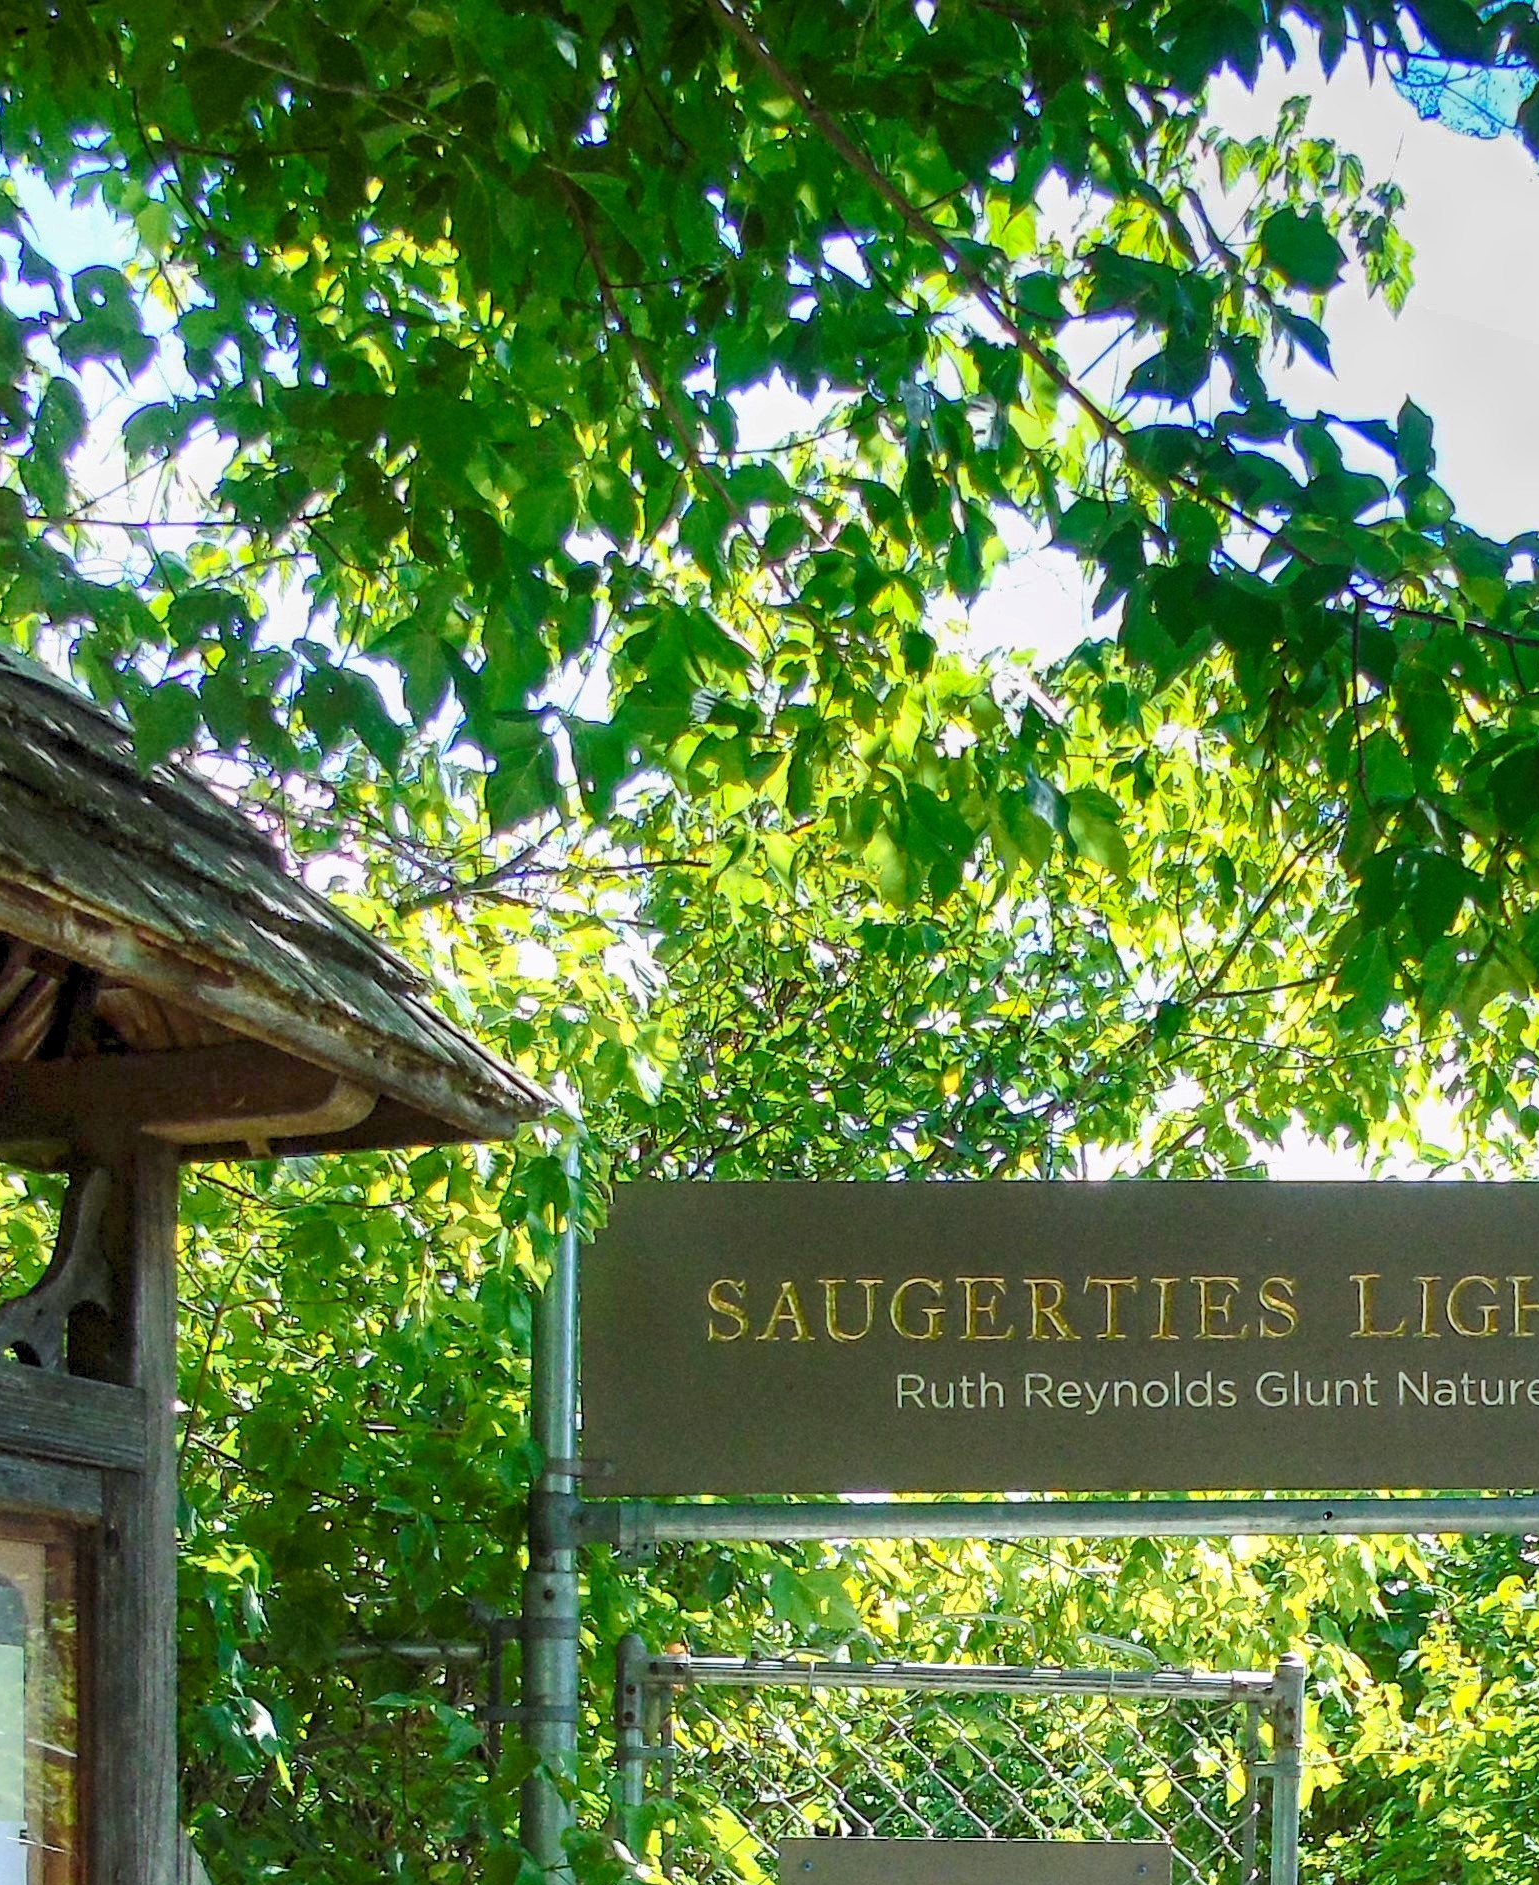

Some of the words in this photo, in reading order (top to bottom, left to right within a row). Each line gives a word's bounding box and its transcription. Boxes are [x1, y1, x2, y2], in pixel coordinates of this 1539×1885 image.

[706, 1276, 1300, 1343] SAUGERTIES
[896, 1373, 1005, 1409] Ruth
[1024, 1370, 1238, 1415] Reynolds
[1254, 1370, 1379, 1407] Glunt
